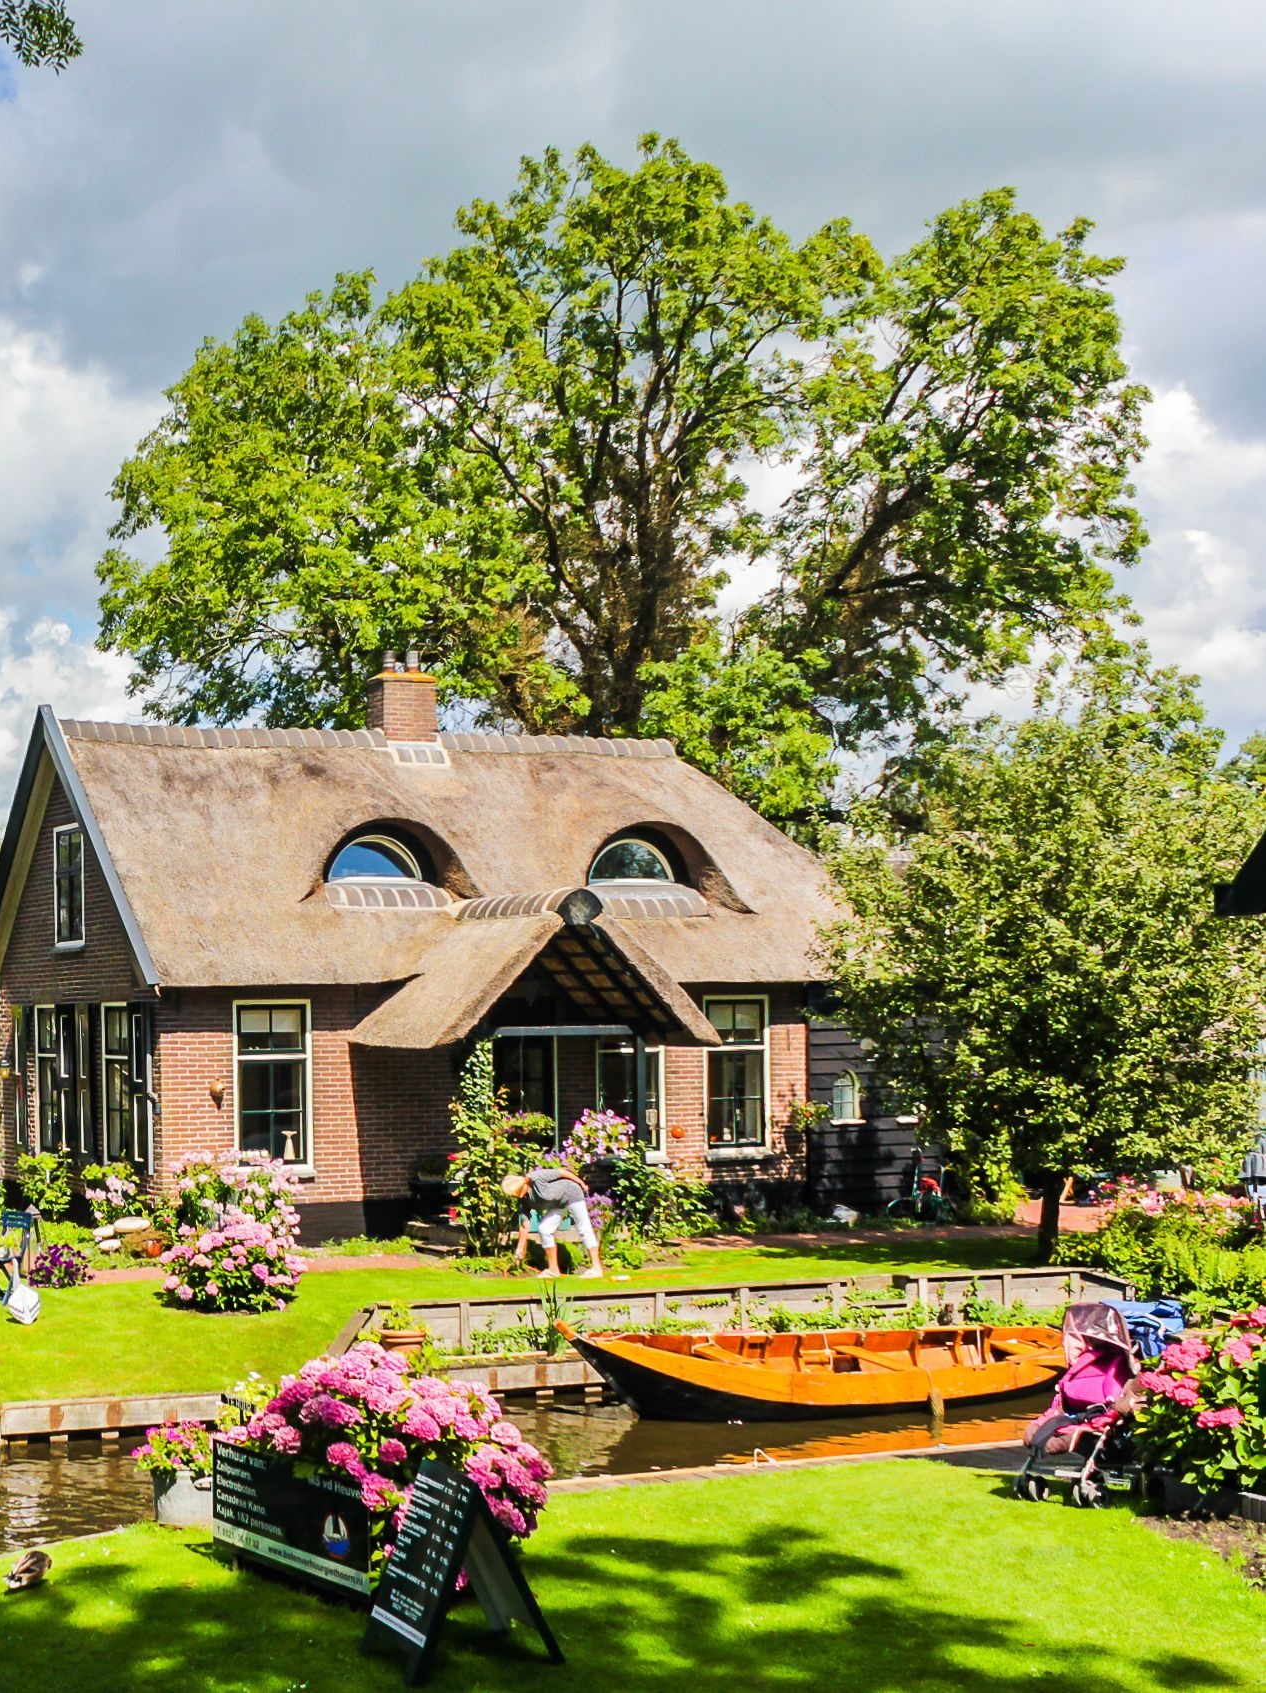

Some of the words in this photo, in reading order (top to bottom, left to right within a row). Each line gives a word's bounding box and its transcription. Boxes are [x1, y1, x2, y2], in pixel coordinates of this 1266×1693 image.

[216, 1442, 247, 1464] Verhuur
[216, 1489, 247, 1508] Canadese
[334, 1481, 361, 1500] Heuve
